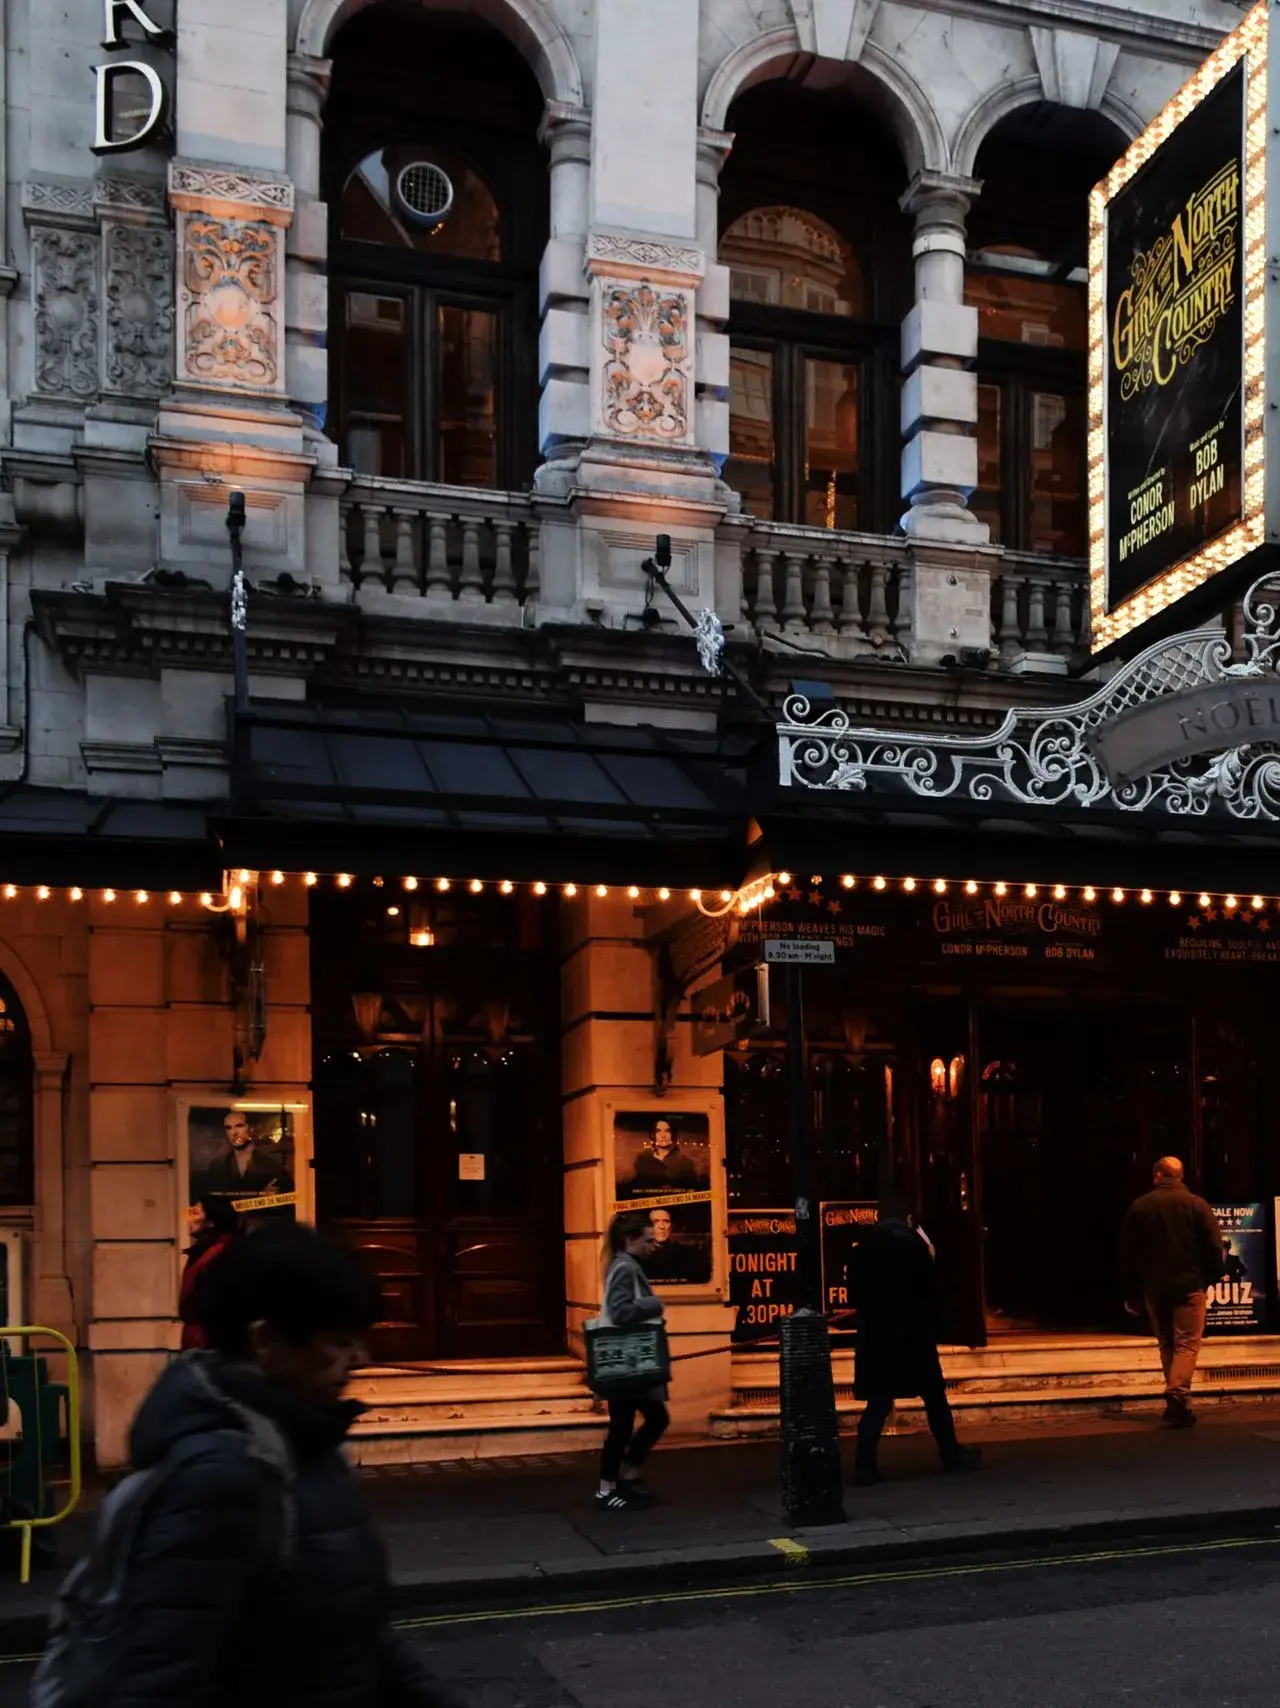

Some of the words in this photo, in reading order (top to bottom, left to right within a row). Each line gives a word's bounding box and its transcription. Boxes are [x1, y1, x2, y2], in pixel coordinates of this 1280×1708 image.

[1172, 172, 1240, 297] NORTH
[1113, 285, 1160, 371] GIRL
[1152, 255, 1237, 386] COUNTRY
[1196, 438, 1218, 476] BOB
[1190, 464, 1224, 510] DYLAN
[1130, 482, 1163, 525] CONOR
[797, 922, 836, 935] WEAVES
[839, 924, 855, 935] HIS
[857, 925, 887, 937] MAGIC
[932, 901, 974, 933] GIRL
[985, 900, 1036, 930] NORTH
[1037, 902, 1102, 937] COUNTRY
[780, 942, 791, 950] No
[792, 942, 820, 952] loading
[941, 942, 973, 956] CONOR
[1044, 946, 1064, 959] BOB
[1066, 946, 1095, 960] DYLAN
[1233, 1207, 1254, 1217] NOW
[727, 1252, 797, 1273] TONIGHT
[751, 1278, 774, 1298] AT
